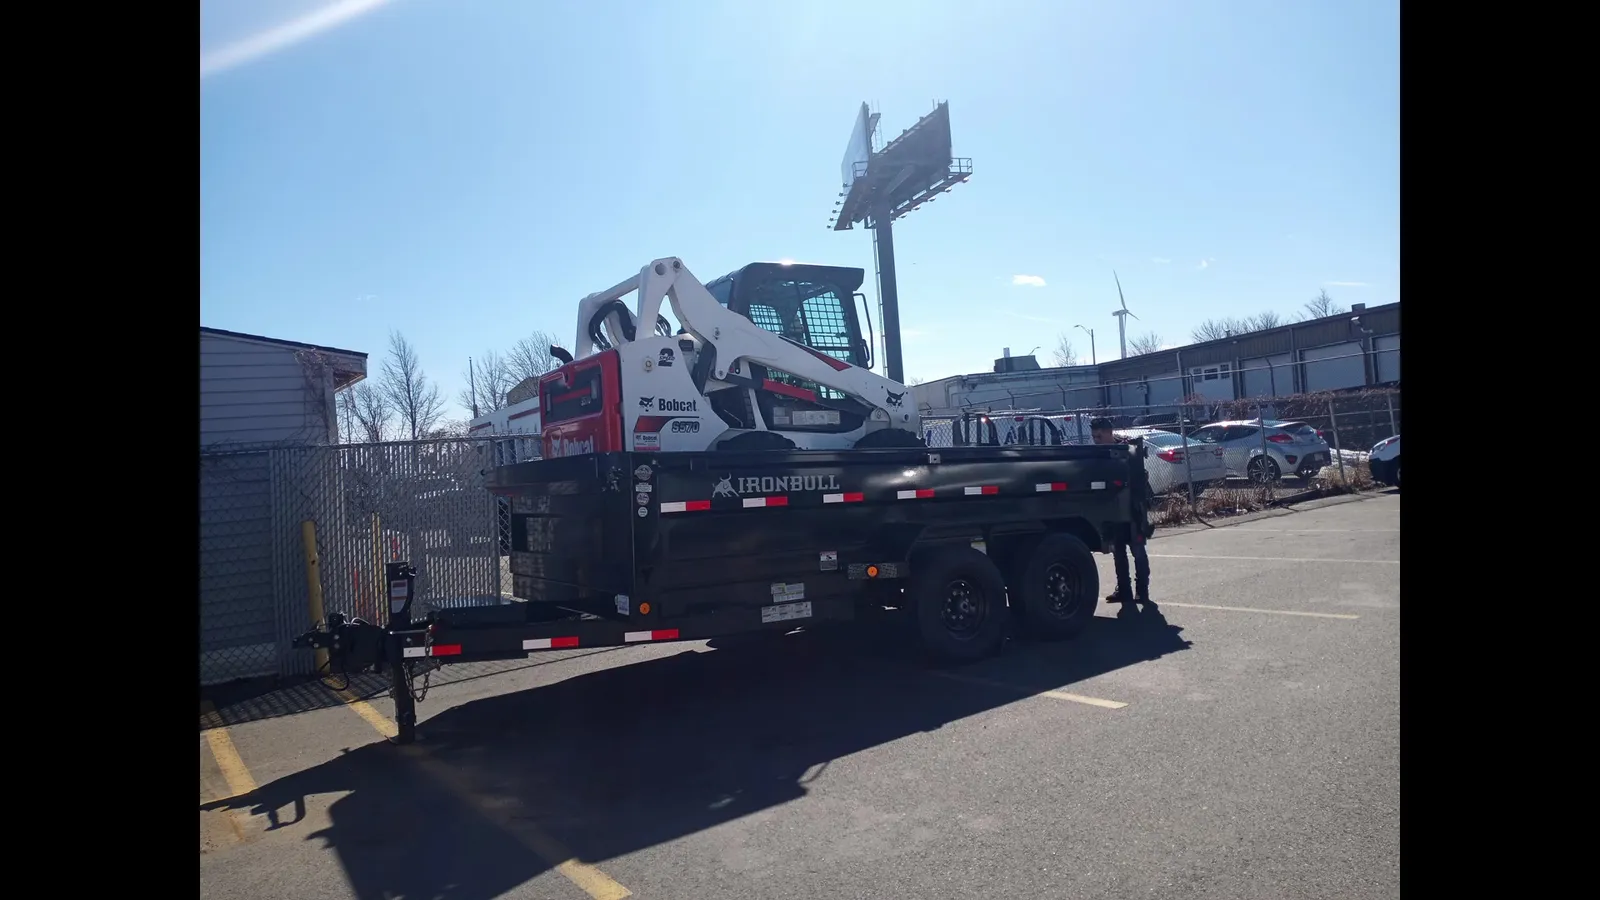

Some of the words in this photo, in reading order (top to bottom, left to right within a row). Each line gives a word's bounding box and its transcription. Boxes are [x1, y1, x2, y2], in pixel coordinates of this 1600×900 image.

[658, 347, 674, 367] 2
[658, 398, 697, 412] Bobcat
[671, 420, 700, 434] S570
[738, 474, 840, 493] IRONBULL
